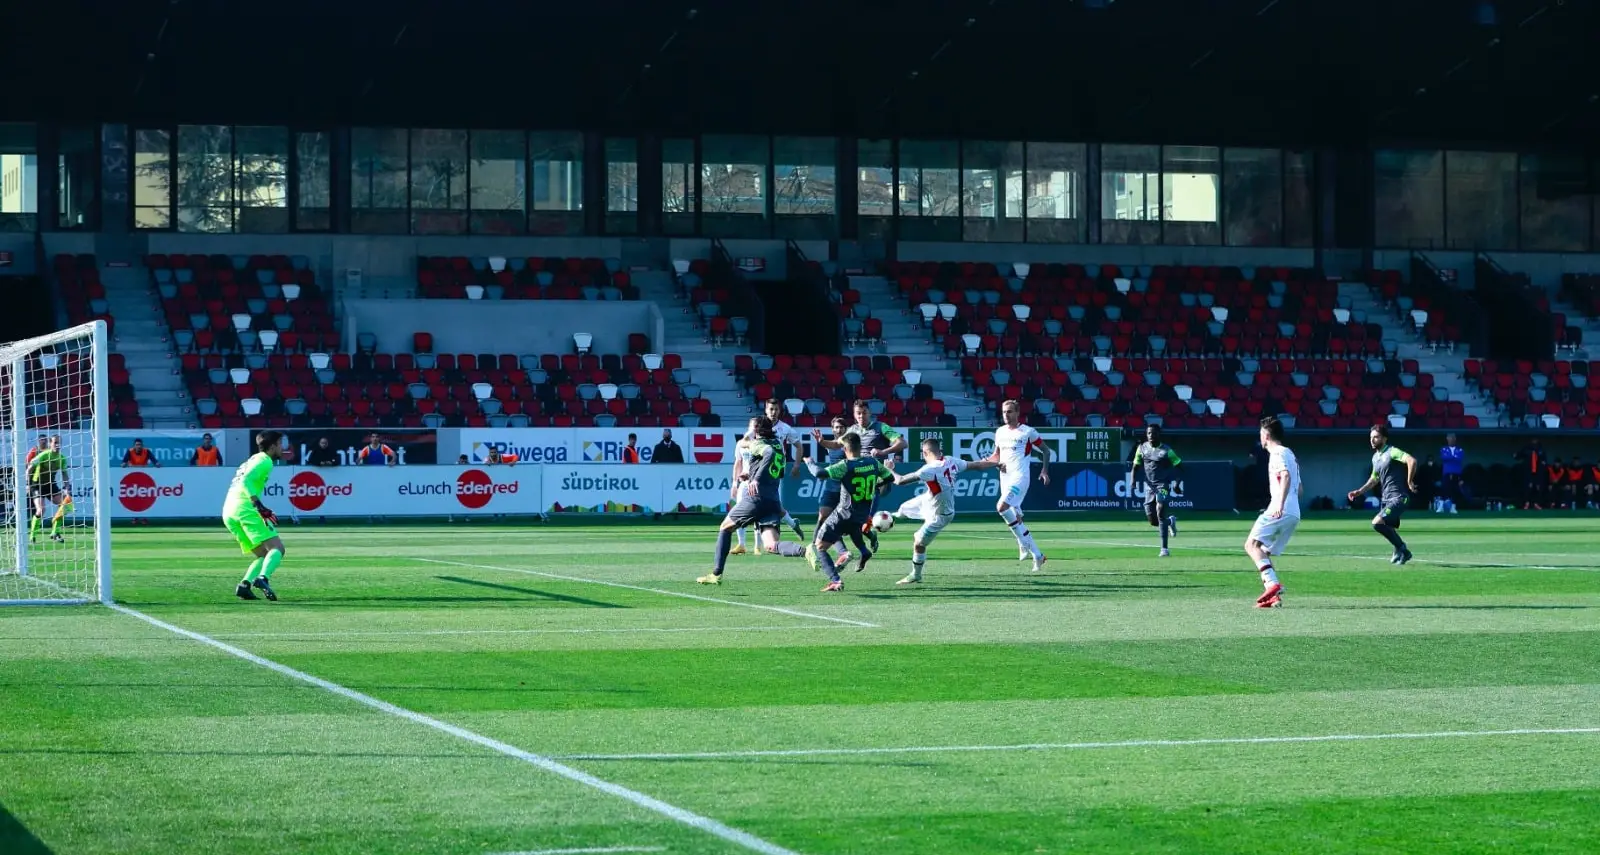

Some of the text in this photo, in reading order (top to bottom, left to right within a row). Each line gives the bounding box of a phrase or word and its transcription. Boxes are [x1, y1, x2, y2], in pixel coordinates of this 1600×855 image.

[1086, 431, 1109, 440] BIRRA
[952, 431, 1077, 462] FOST
[1086, 451, 1109, 460] BEER
[119, 483, 184, 498] Edenred
[288, 482, 353, 497] Edenred
[398, 480, 519, 495] eLunch Edenred
[851, 474, 877, 502] 30
[1058, 500, 1120, 508] Die Duschkabine
[1168, 500, 1194, 508] doccia
